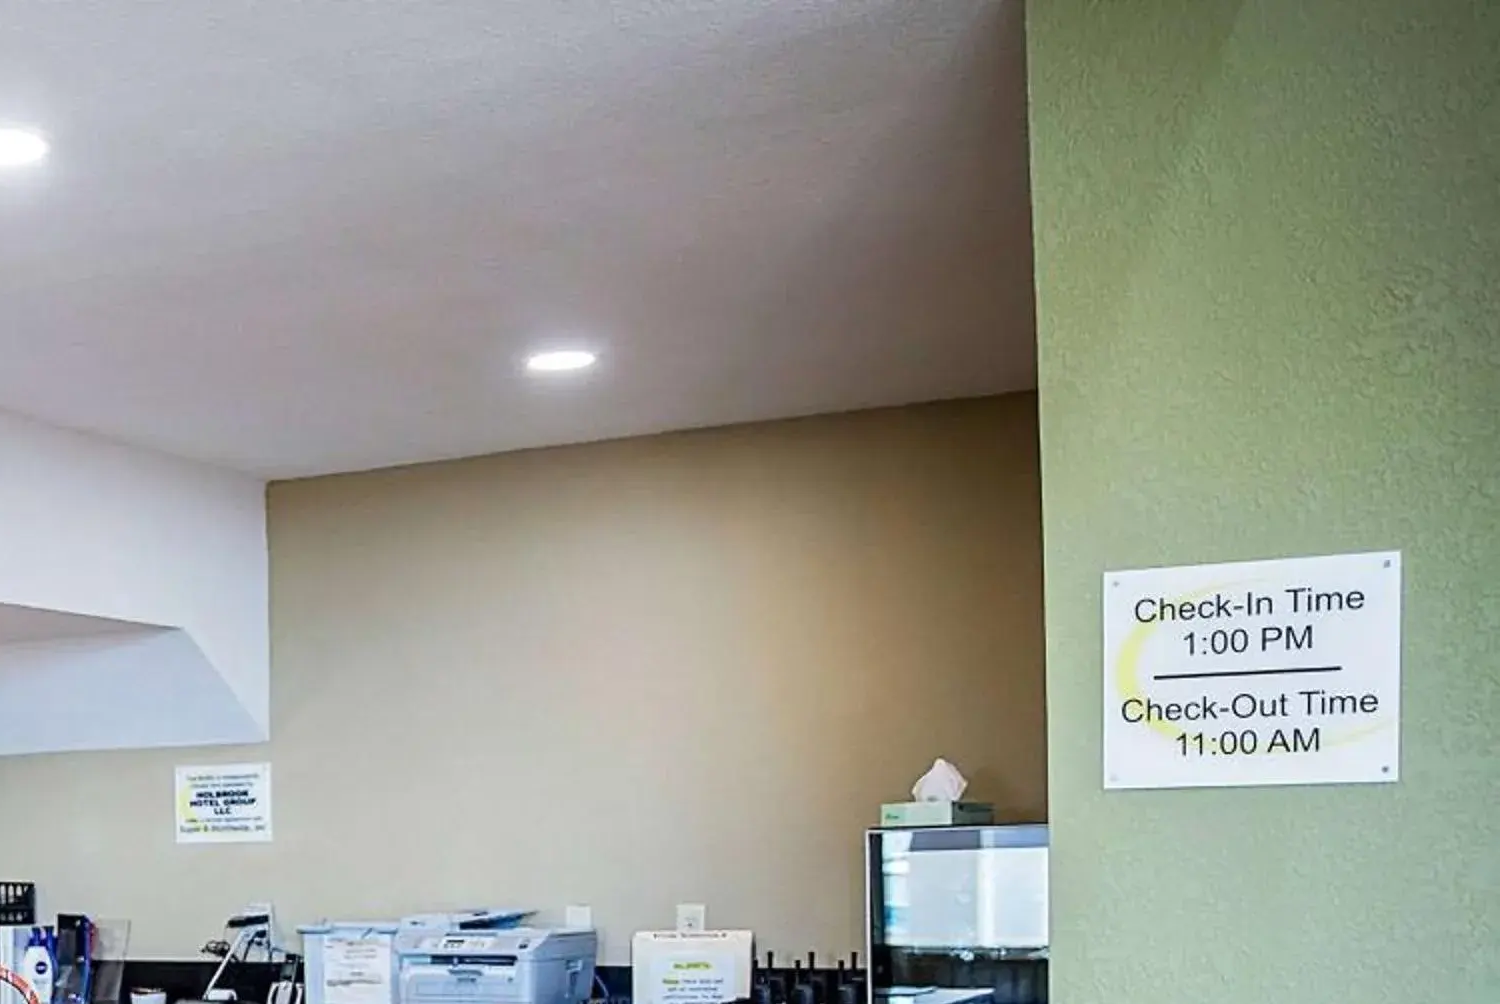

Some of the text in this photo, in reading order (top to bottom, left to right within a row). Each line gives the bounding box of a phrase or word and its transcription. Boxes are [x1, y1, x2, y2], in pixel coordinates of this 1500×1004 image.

[1134, 587, 1366, 623] Check-In Time
[1182, 625, 1314, 656] 1:00 PM
[1121, 690, 1379, 724] Check-Out Time
[1175, 727, 1321, 757] 11:00 AM
